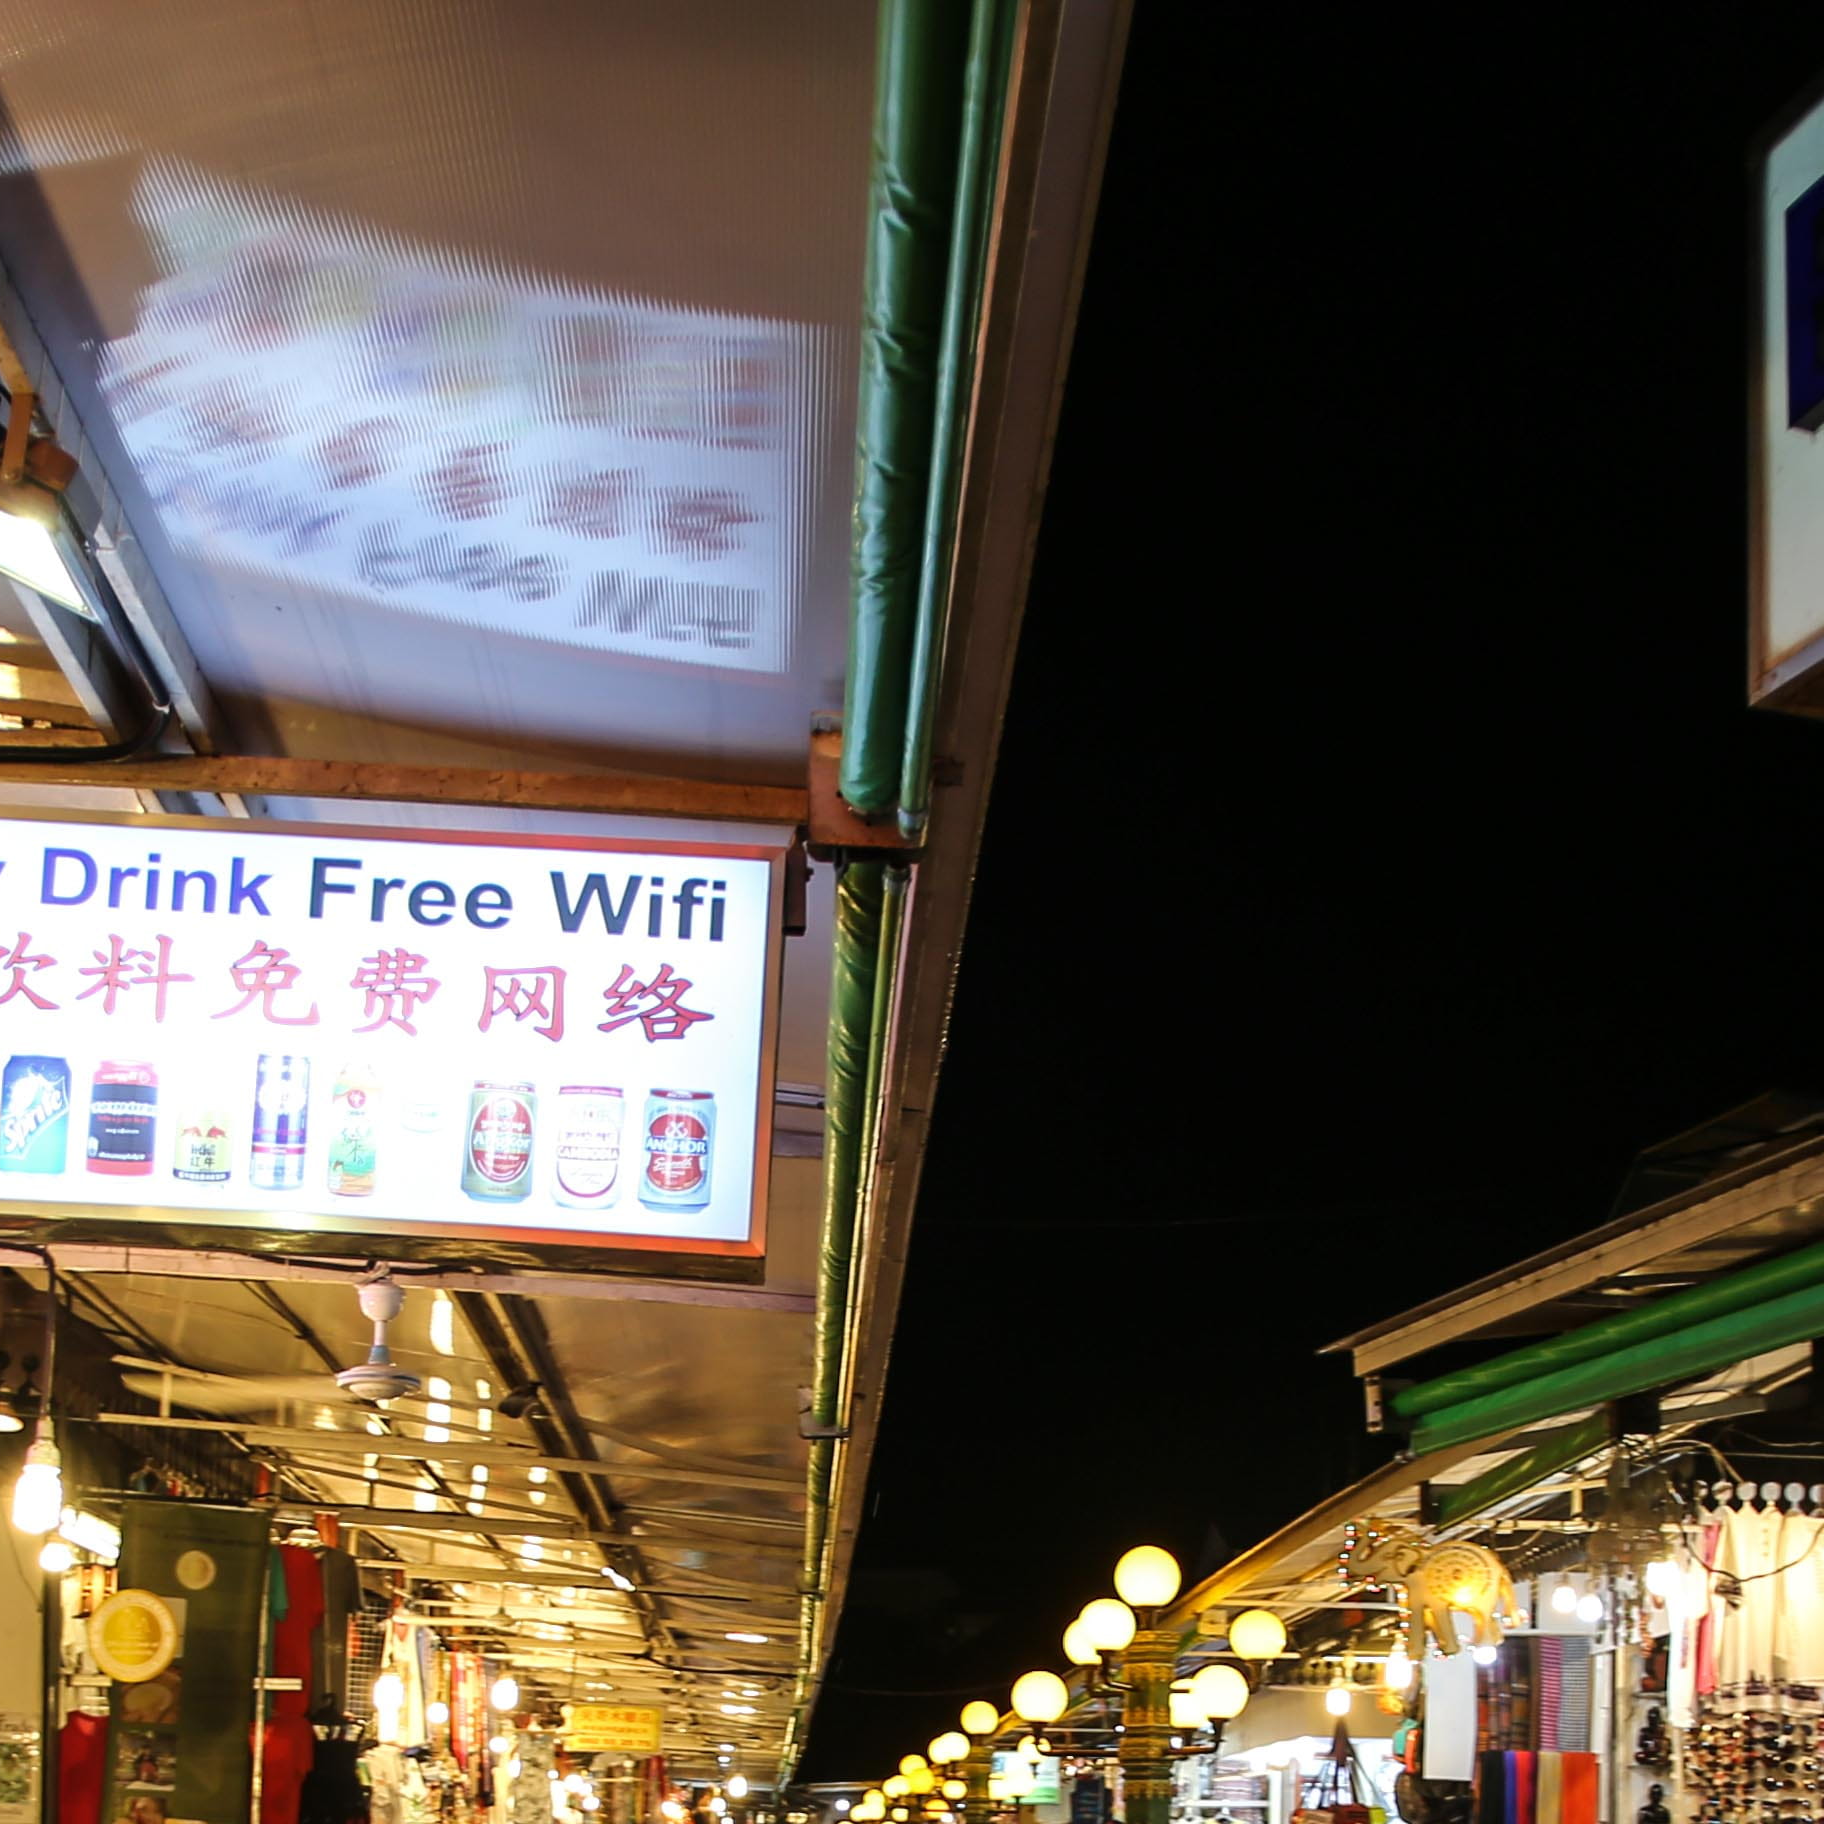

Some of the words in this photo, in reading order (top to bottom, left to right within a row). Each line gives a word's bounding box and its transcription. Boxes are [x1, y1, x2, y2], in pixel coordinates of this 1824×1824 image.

[40, 846, 272, 917] Drink
[308, 856, 514, 930] Free
[549, 870, 728, 943] Wifi
[645, 1137, 707, 1155] ANCHOR
